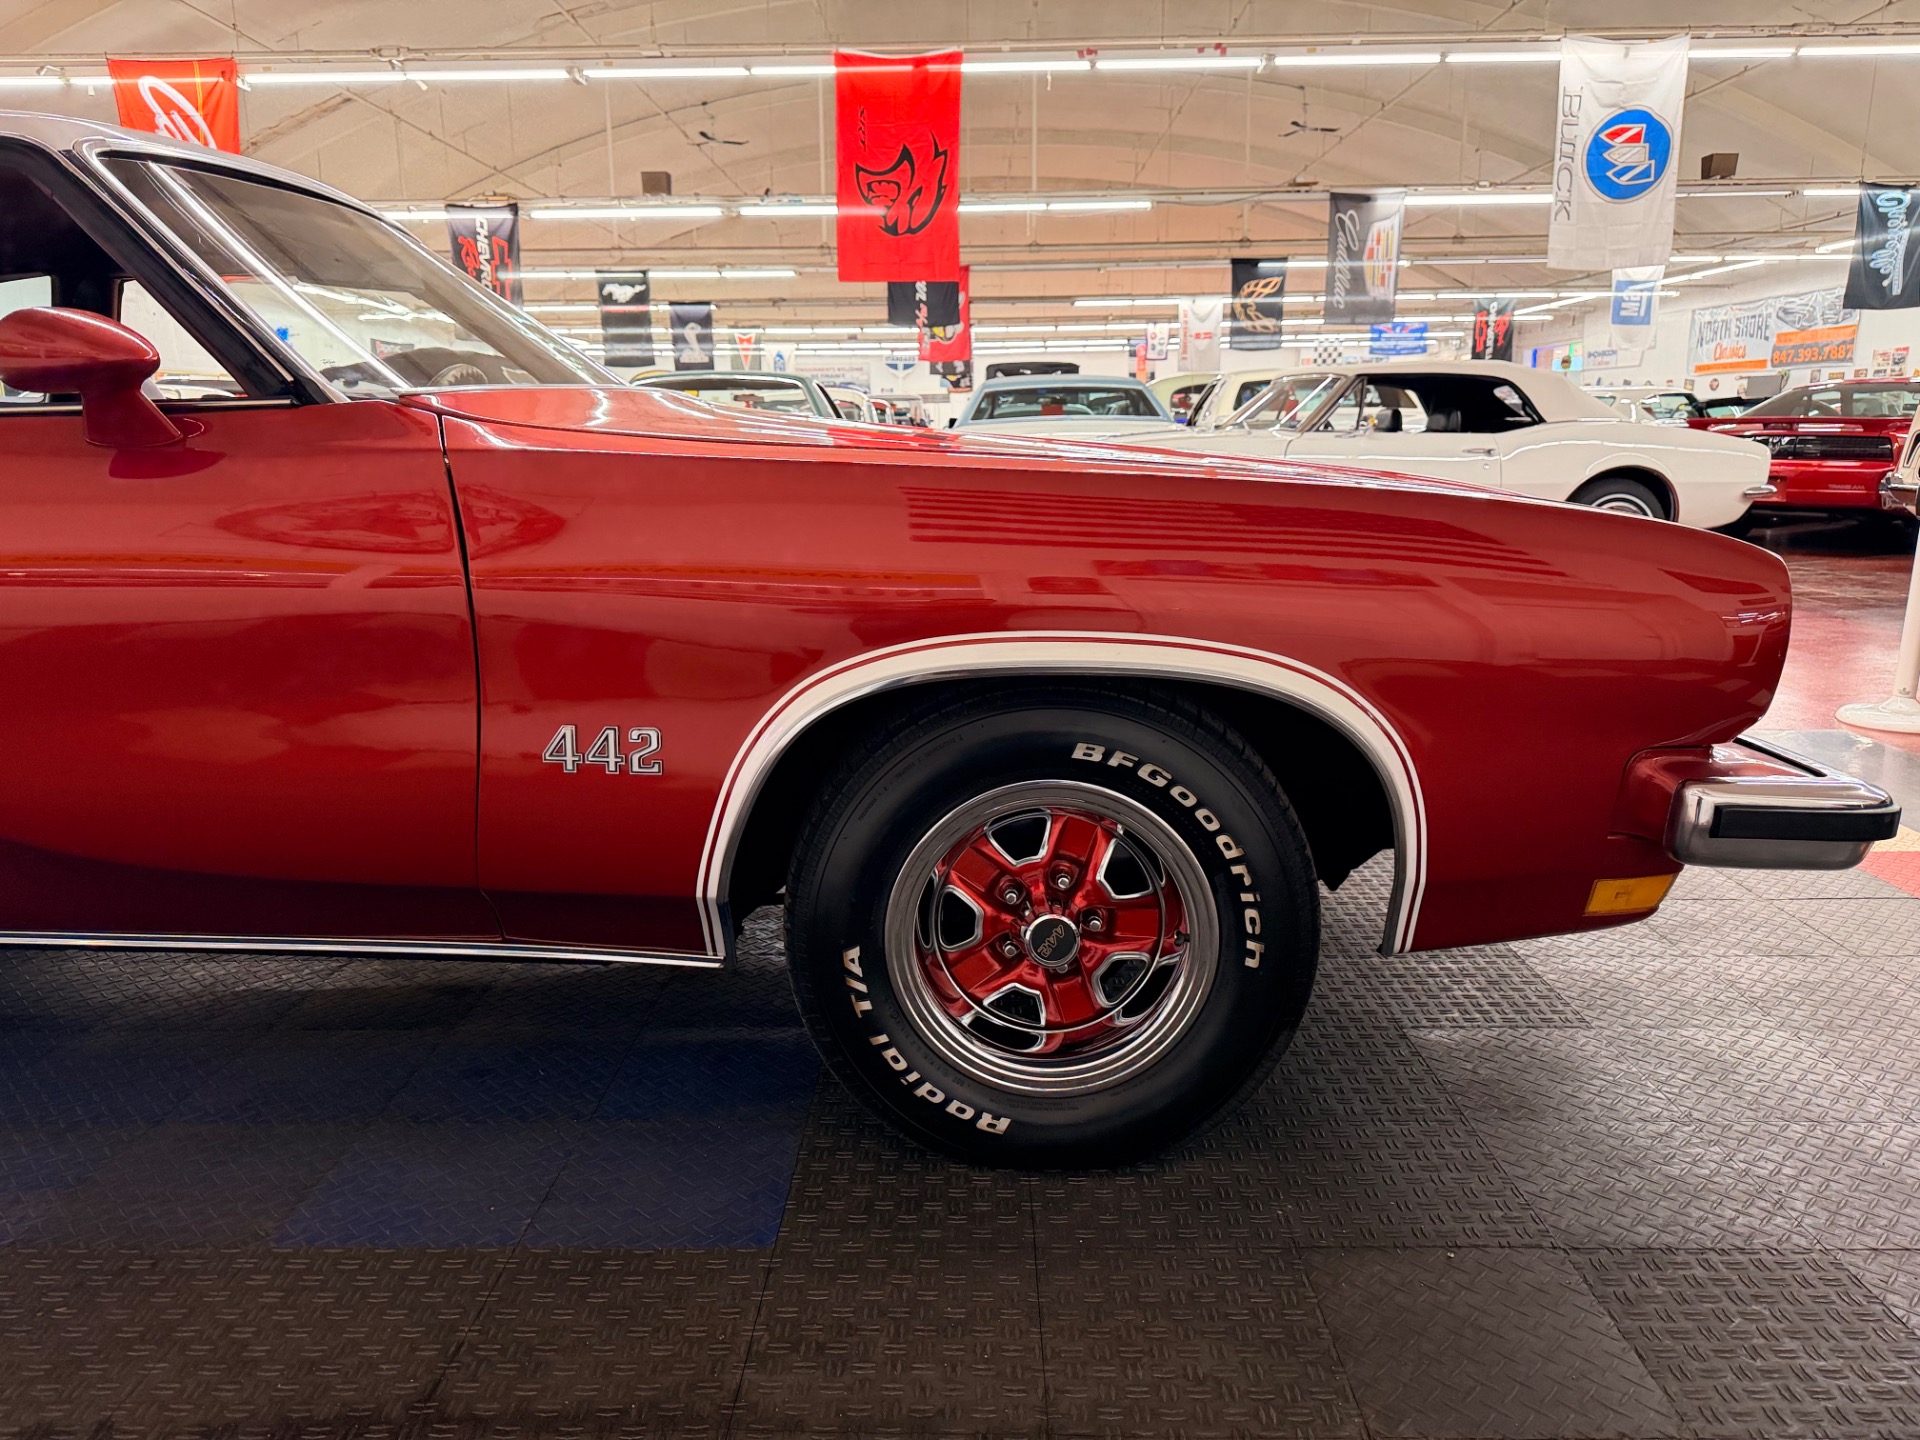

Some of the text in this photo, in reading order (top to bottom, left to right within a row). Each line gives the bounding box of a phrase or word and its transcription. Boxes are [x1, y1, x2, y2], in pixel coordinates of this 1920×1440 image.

[1553, 86, 1583, 222] BUICK
[1332, 209, 1360, 310] Cadillac
[1696, 319, 1733, 350] NORTH
[1734, 312, 1772, 342] SHORE
[1773, 343, 1854, 364] 847.393.7887
[542, 725, 663, 775] 442
[1071, 742, 1265, 969] BFGoodrich
[842, 945, 873, 1018] T/A
[868, 1033, 1012, 1135] Radial
